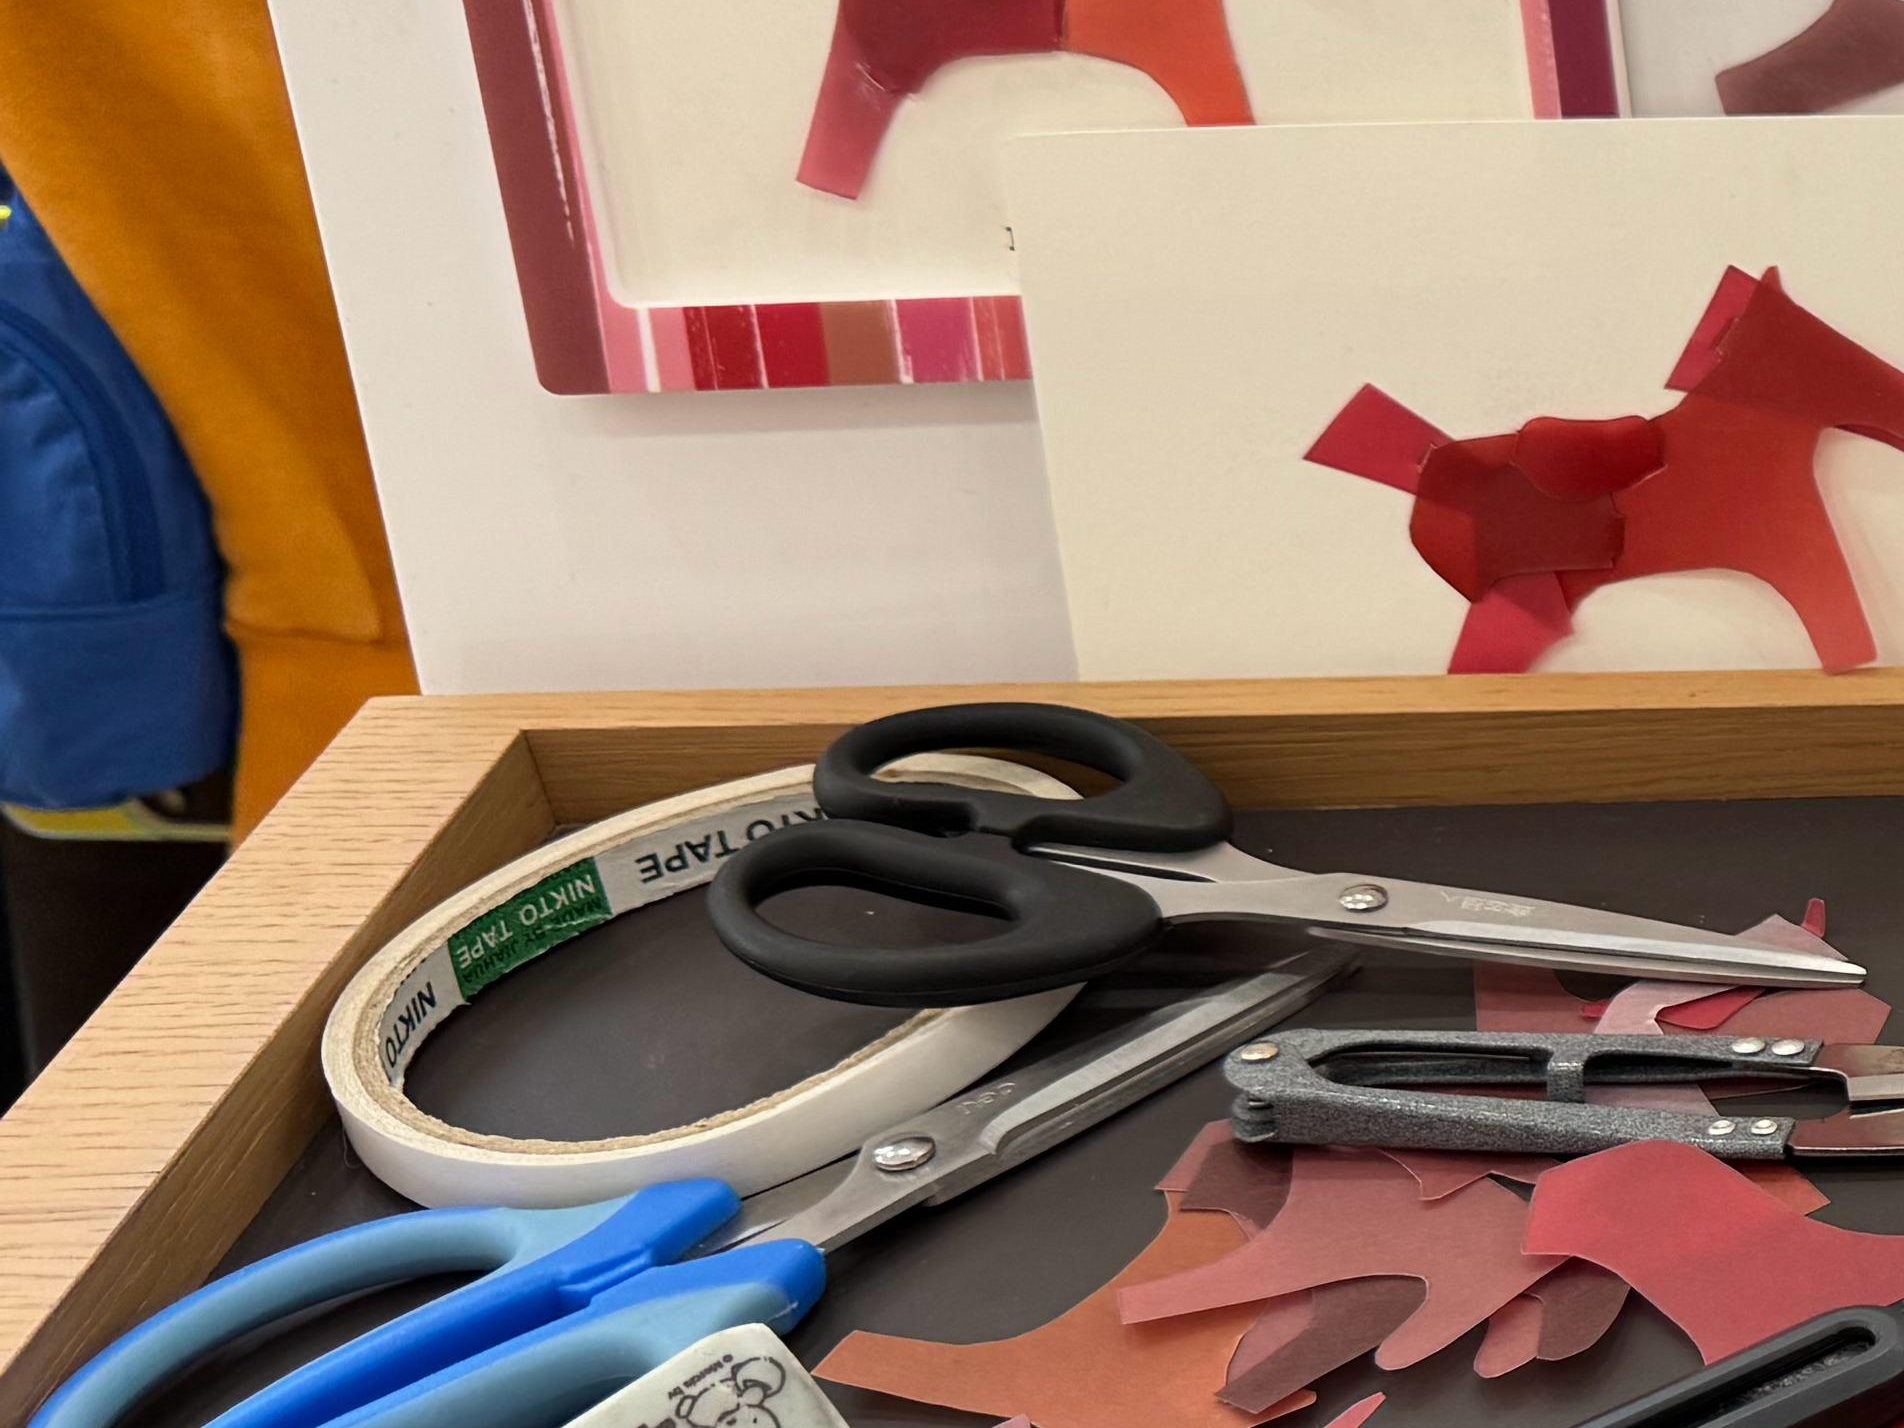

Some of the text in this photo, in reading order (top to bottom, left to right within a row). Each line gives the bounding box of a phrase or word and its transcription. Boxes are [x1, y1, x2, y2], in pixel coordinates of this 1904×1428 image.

[633, 829, 739, 885] TAPE
[454, 872, 598, 969] NIKTO TAPE
[384, 981, 437, 1068] NIKTO
